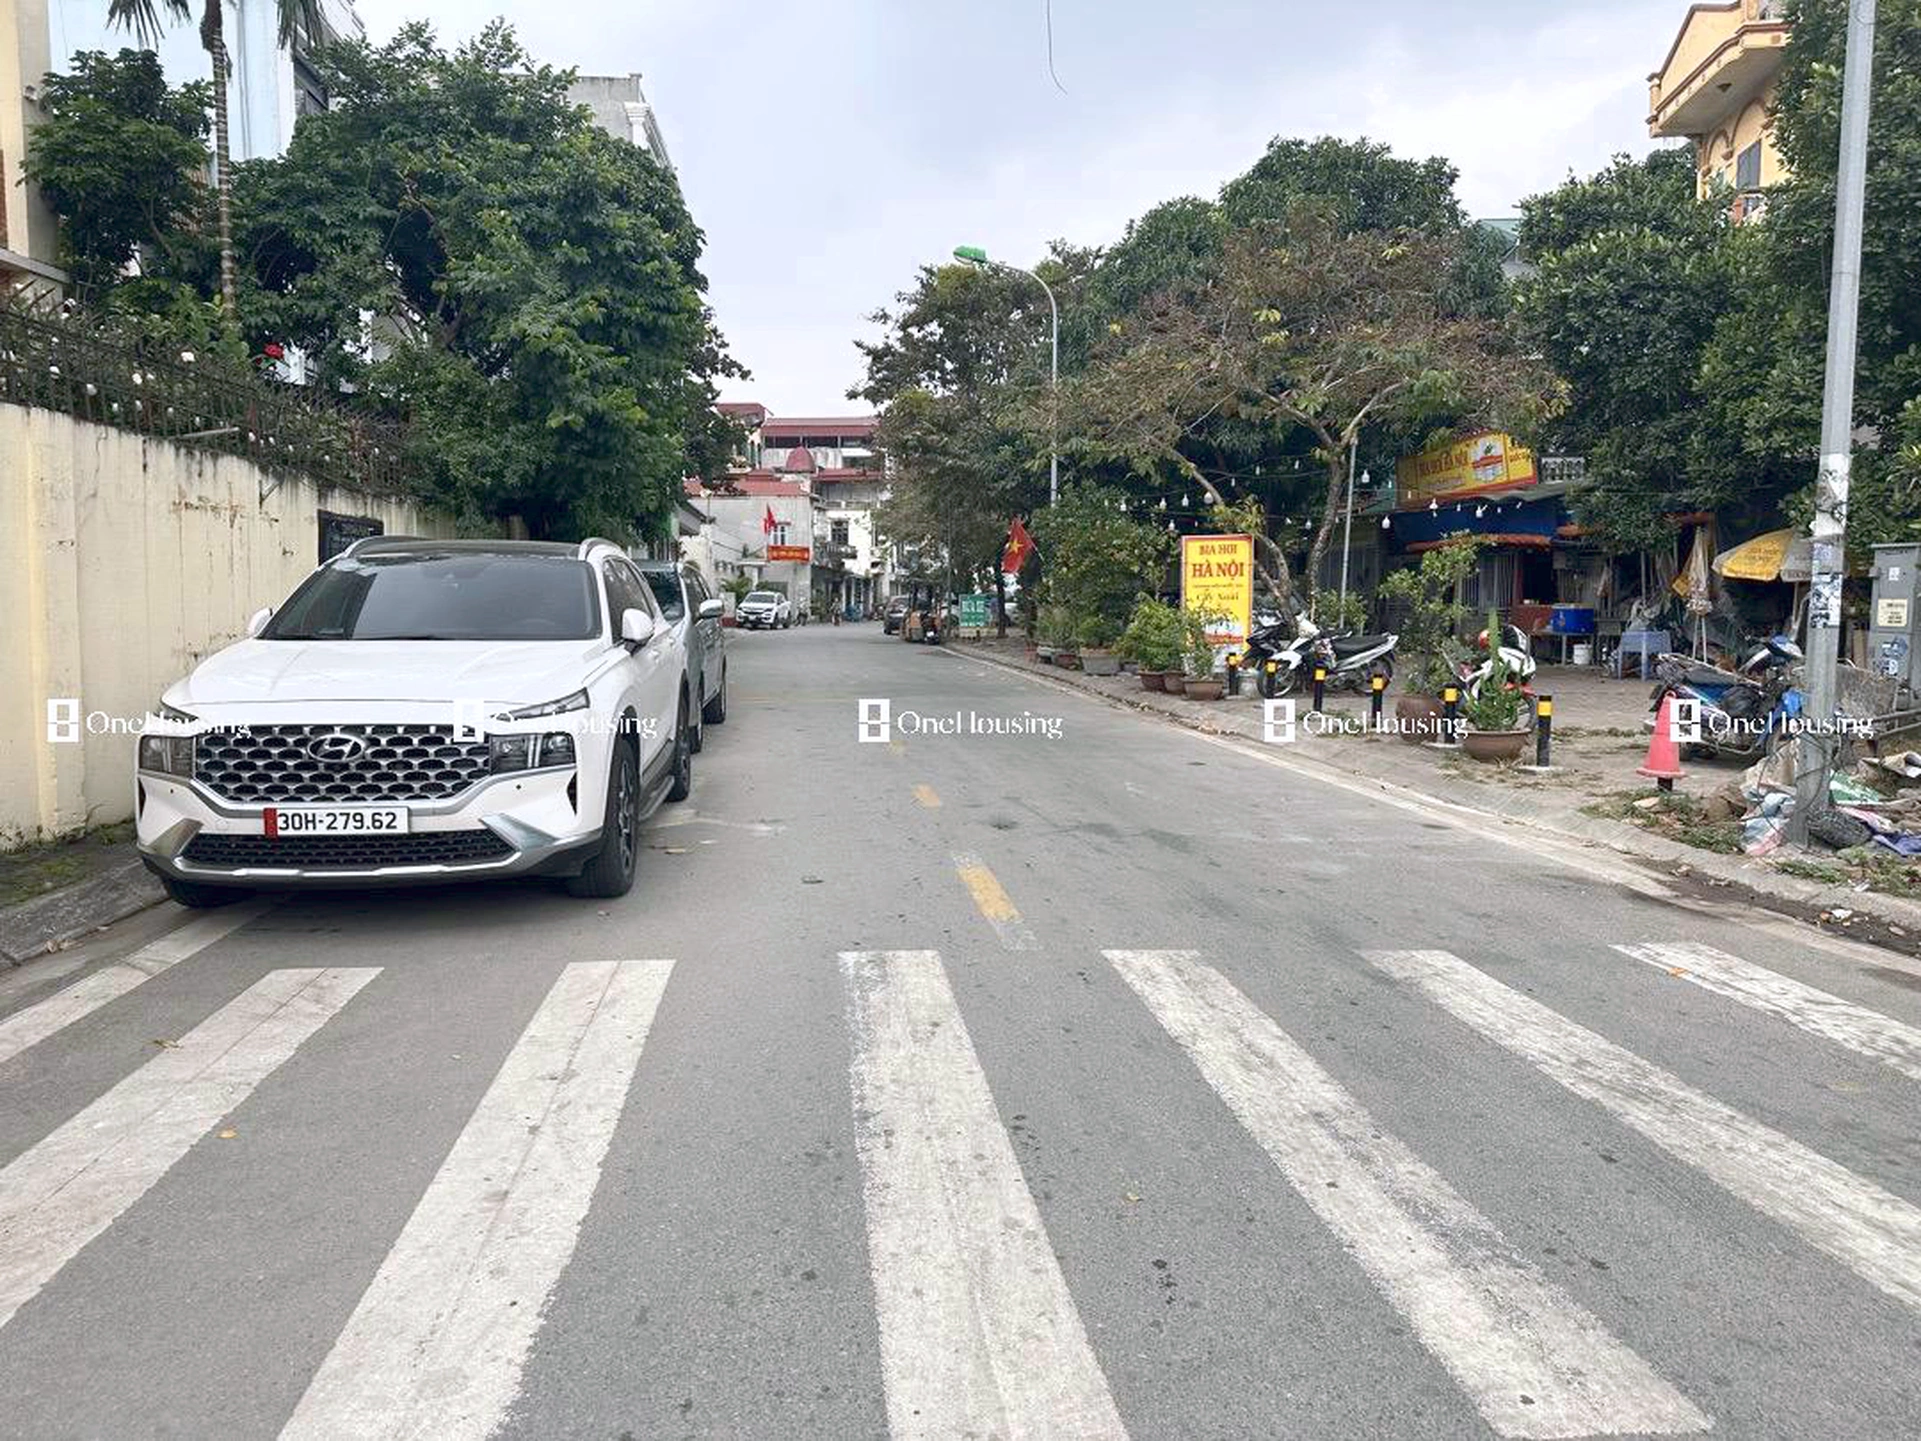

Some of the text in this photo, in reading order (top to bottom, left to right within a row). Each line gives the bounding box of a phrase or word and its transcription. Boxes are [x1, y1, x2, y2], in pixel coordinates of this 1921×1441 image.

[1199, 545, 1215, 556] BIA
[1192, 559, 1244, 580] HÀ NỘI
[277, 811, 398, 831] 30H-279.62
